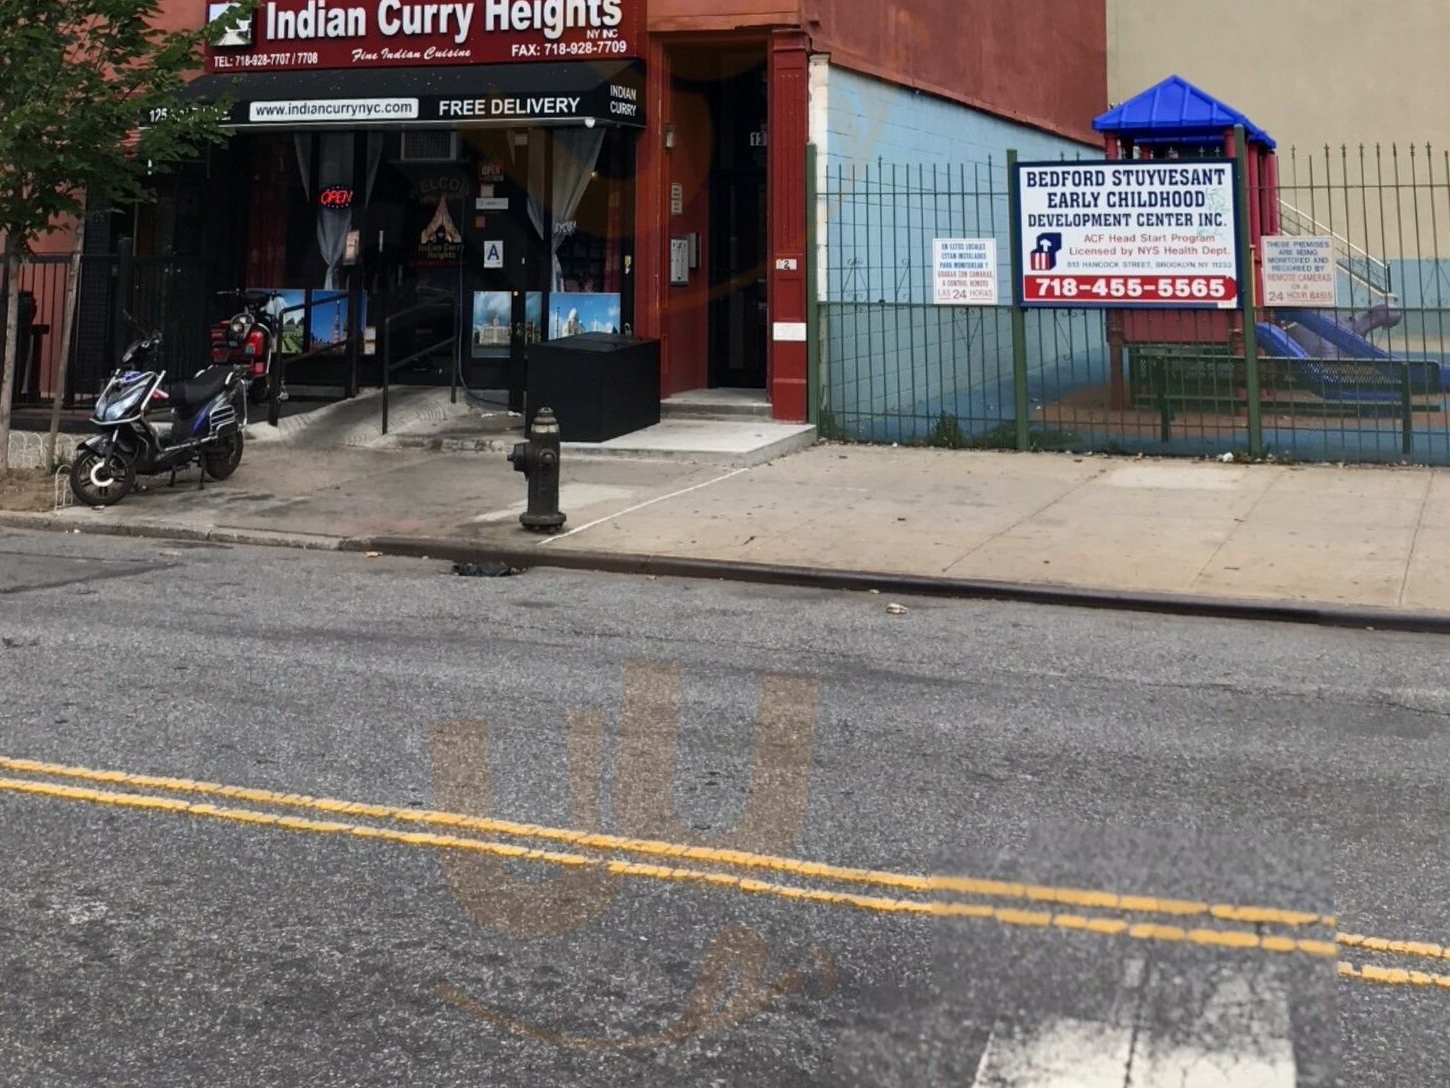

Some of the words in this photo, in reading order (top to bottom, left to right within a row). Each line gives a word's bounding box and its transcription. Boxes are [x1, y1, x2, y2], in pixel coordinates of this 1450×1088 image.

[266, 0, 366, 39] Indian
[587, 30, 600, 39] NY
[602, 29, 618, 38] INC
[351, 49, 378, 62] Fine
[380, 48, 421, 59] Indian
[423, 46, 471, 60] Cuisine
[512, 44, 540, 57] FAX:
[544, 40, 626, 55] 718-928-7709
[214, 55, 232, 67] TEL:
[235, 52, 290, 66] 718-928-7707
[610, 85, 637, 101] INDIAN
[255, 100, 413, 117] www.indiancurrynyc.com
[439, 100, 485, 116] FREE
[491, 97, 581, 115] DELIVERY
[610, 101, 637, 117] CURRY
[1026, 170, 1105, 188] BEDFORD
[1112, 168, 1225, 187] STUYVESANT
[320, 190, 352, 204] OPEN
[1047, 192, 1101, 209] EARLY
[1106, 190, 1205, 208] CHILDHOOD
[1028, 213, 1131, 228] DEVELOPMENT
[1137, 213, 1193, 227] CENTER
[1198, 213, 1227, 227] INC.
[1084, 234, 1104, 243] ACF
[1109, 233, 1136, 243] Head
[1140, 233, 1167, 243] Start
[1171, 233, 1216, 245] Program
[487, 245, 499, 260] A
[1069, 246, 1117, 256] Licensed
[1121, 246, 1134, 258] by
[1137, 246, 1160, 256] NYS
[1164, 245, 1198, 255] Health
[1202, 246, 1230, 257] Dept.
[952, 289, 967, 299] 24
[1035, 278, 1226, 298] 718-455-5565
[1268, 291, 1284, 301] 24
